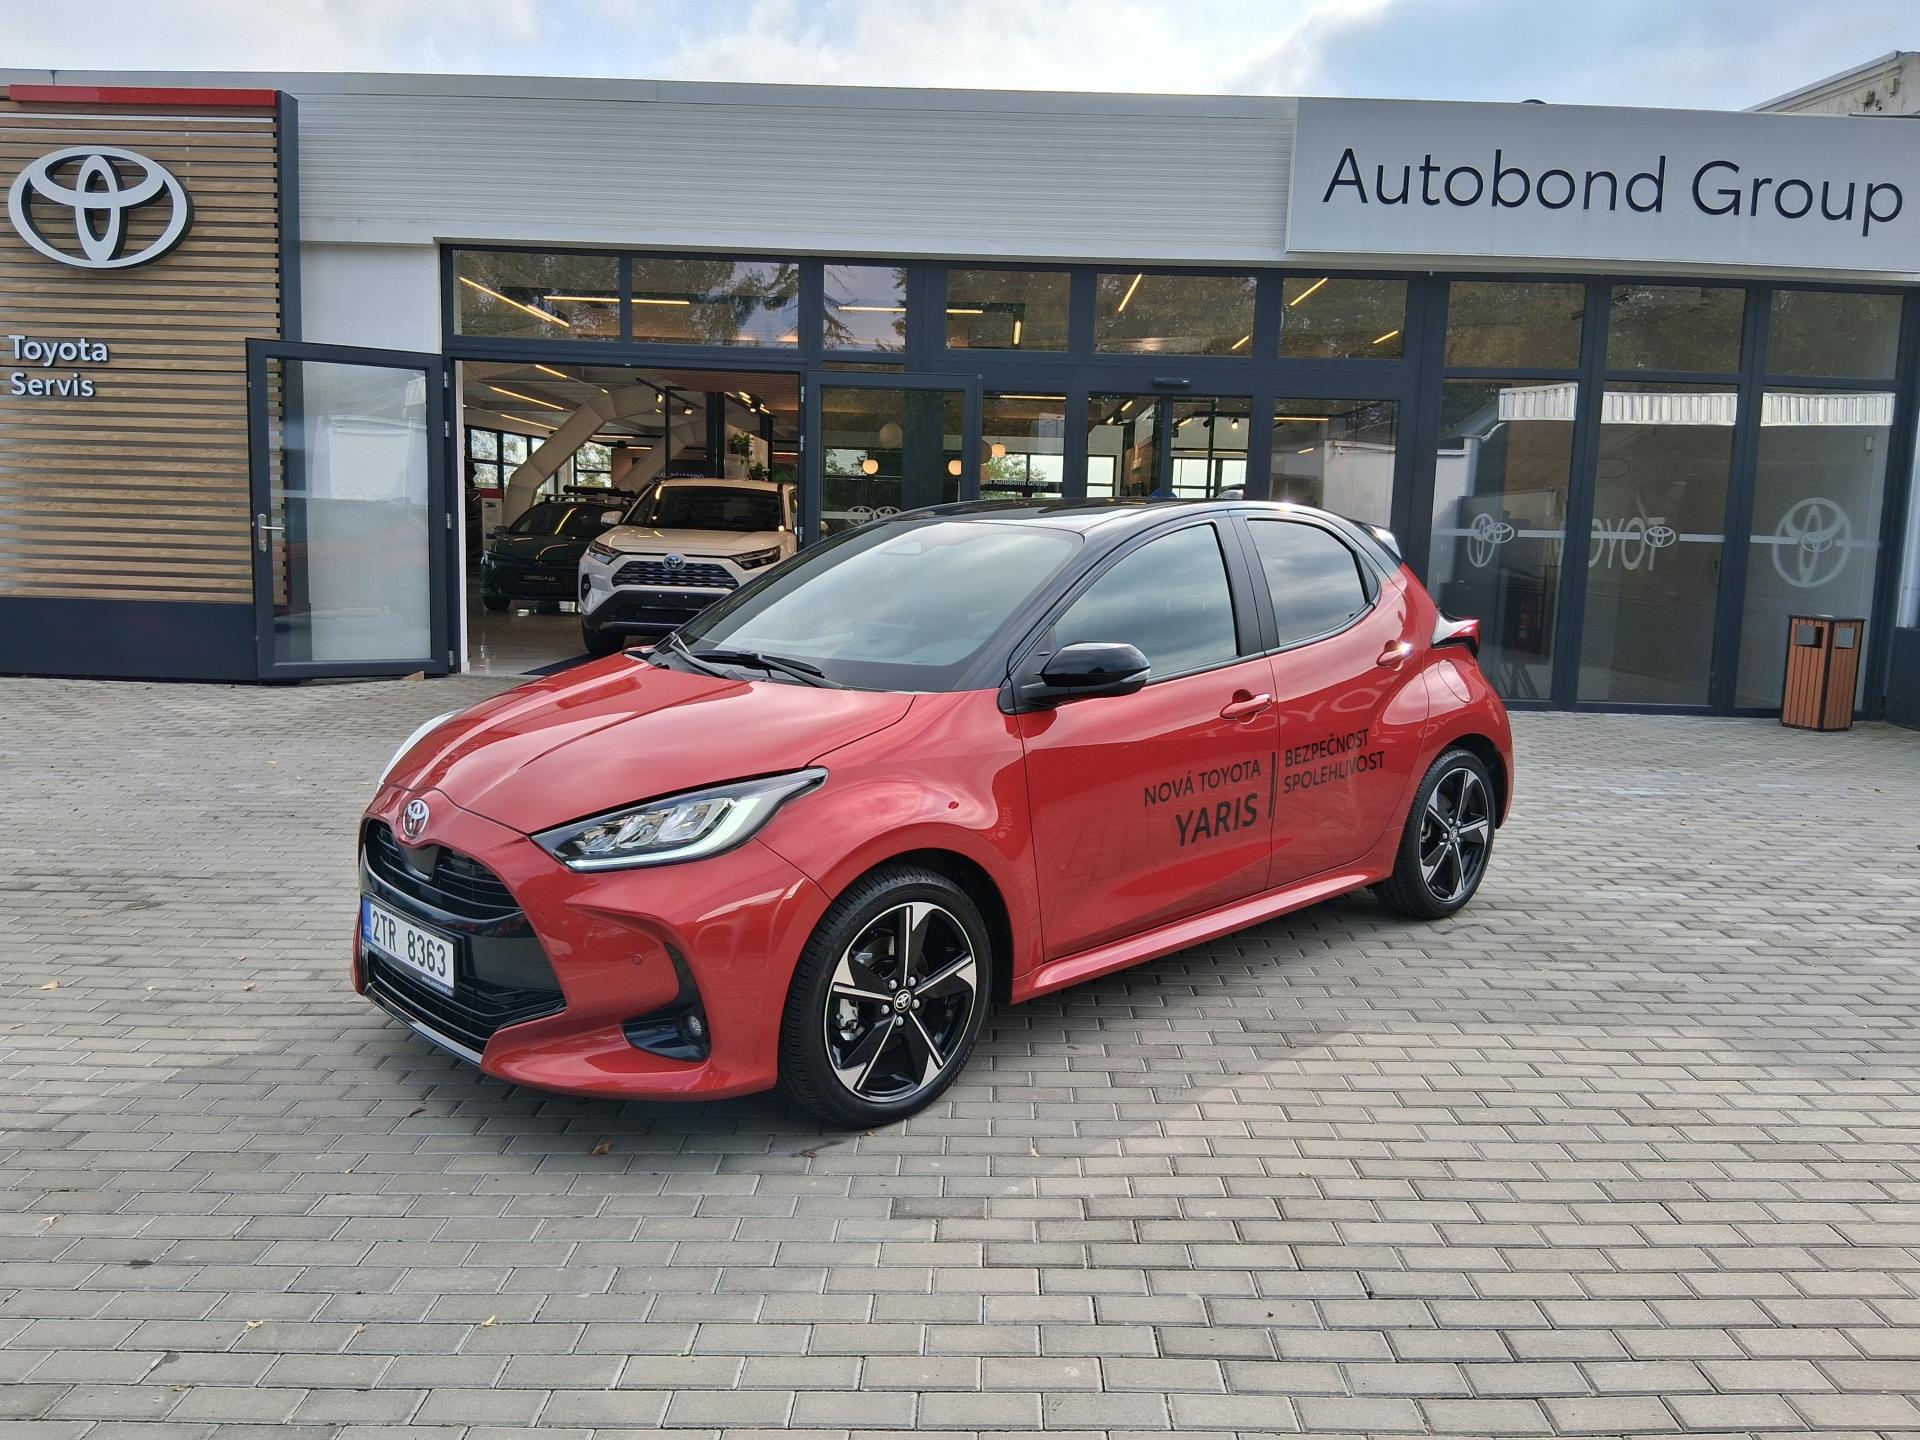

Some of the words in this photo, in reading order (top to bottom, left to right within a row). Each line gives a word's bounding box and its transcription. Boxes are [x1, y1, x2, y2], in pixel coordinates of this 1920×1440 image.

[1322, 148, 1667, 213] Autobond
[1691, 159, 1904, 238] Group
[8, 334, 109, 367] Toyota
[10, 371, 95, 397] Servis
[1027, 480, 1049, 488] Group
[1285, 727, 1369, 768] BEZPEČNOST
[1144, 770, 1194, 807] NOVÁ
[1199, 758, 1261, 792] TOYOTA
[1283, 750, 1385, 794] SPOLEHLIVOST
[1174, 792, 1259, 847] YARIS
[372, 910, 397, 953] 2TR
[407, 929, 447, 978] 8363
